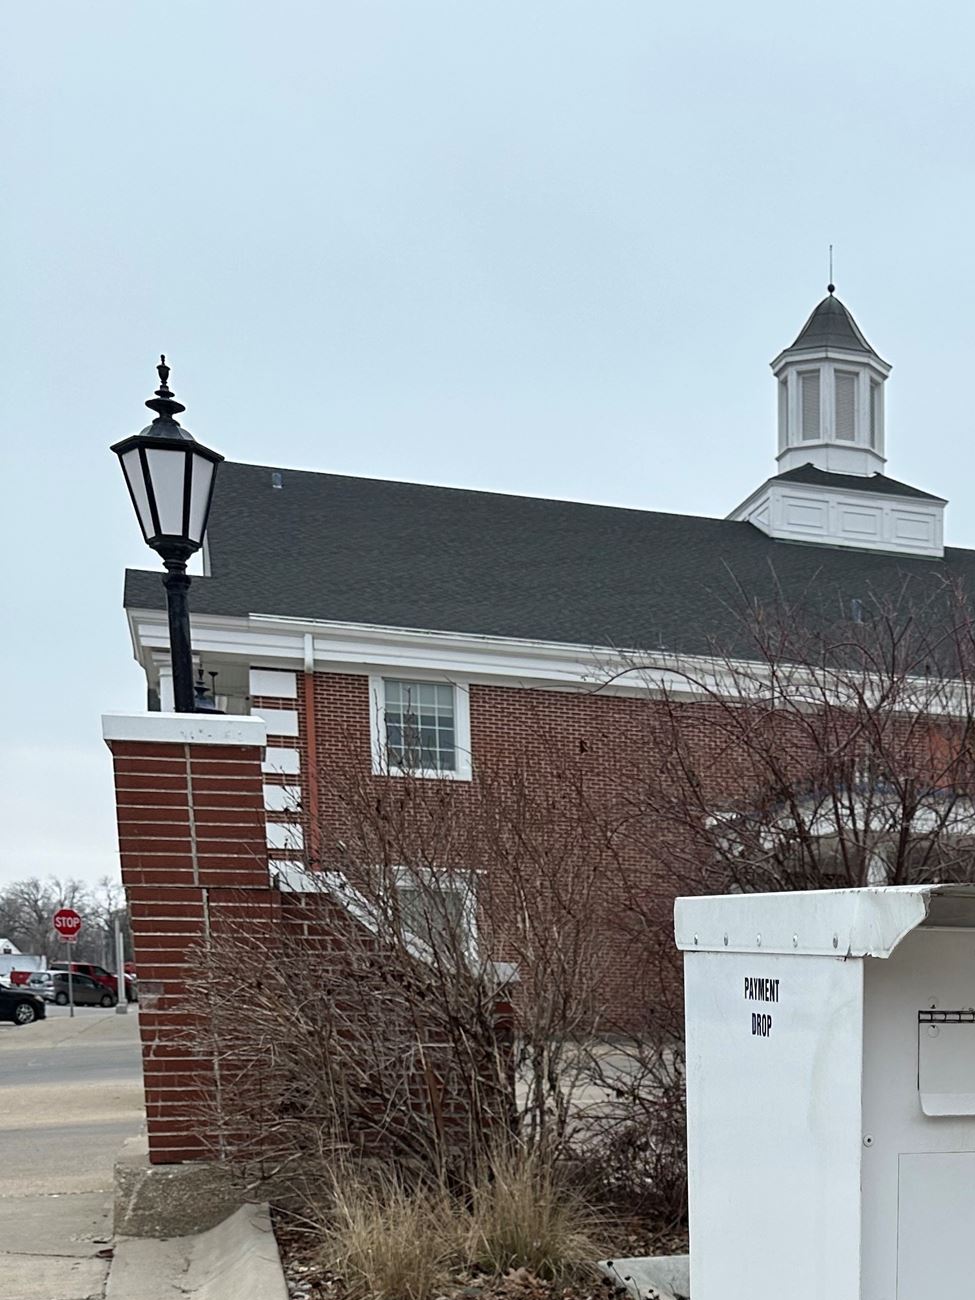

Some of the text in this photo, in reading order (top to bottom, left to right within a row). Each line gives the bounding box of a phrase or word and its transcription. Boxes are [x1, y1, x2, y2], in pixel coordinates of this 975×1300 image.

[55, 916, 80, 928] STOP
[744, 977, 780, 1003] PAYMENT
[751, 1012, 772, 1037] DROP
